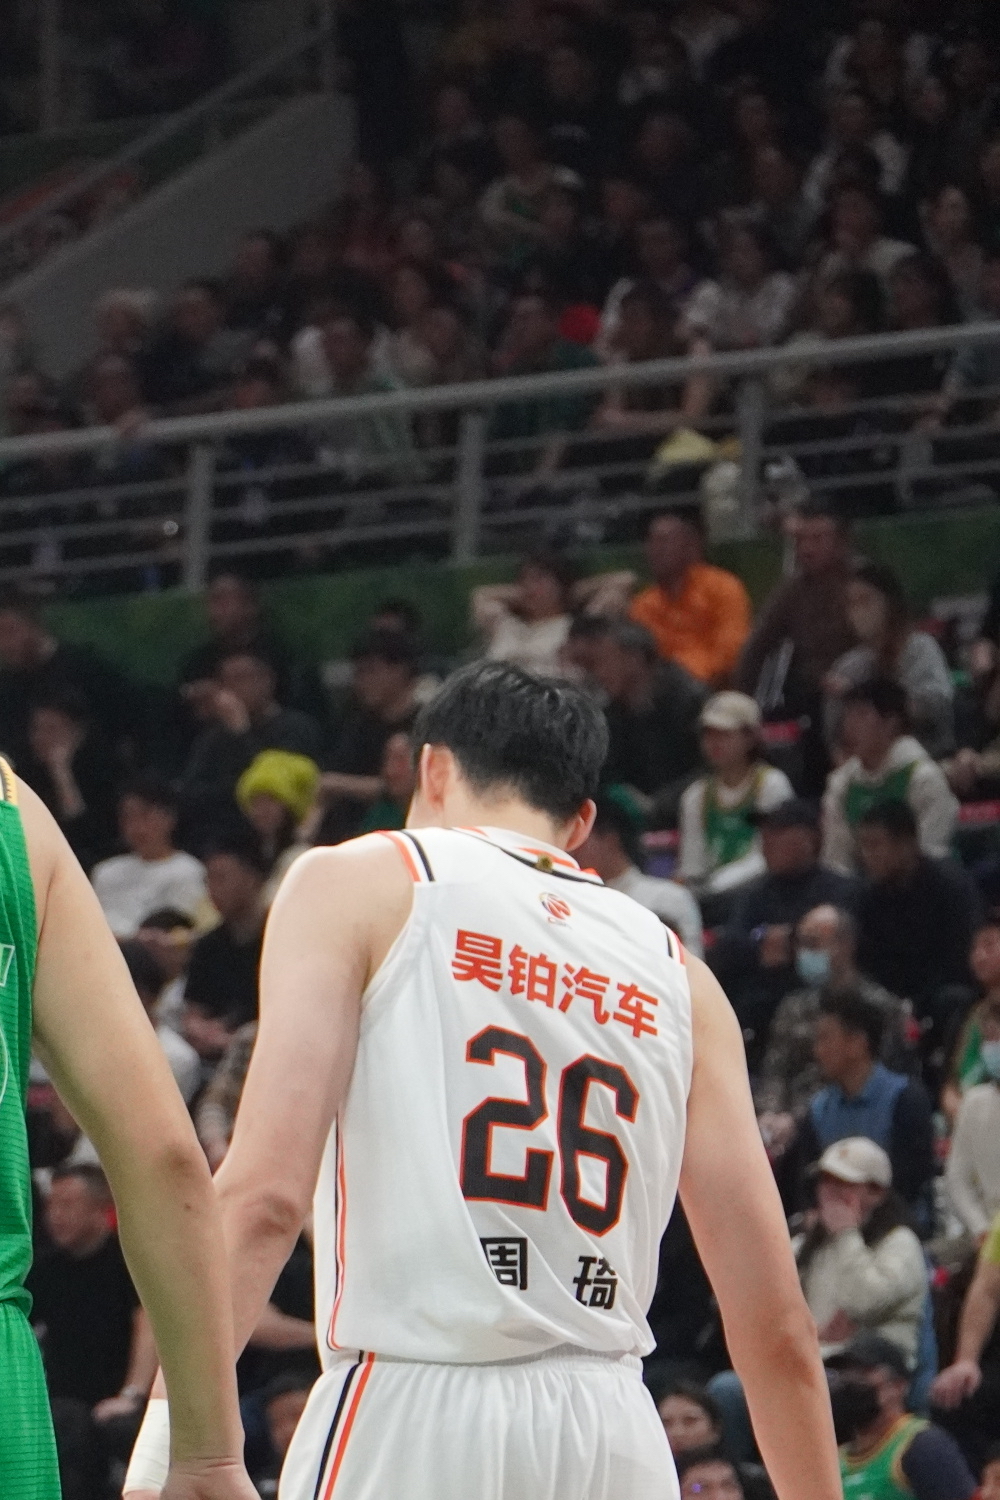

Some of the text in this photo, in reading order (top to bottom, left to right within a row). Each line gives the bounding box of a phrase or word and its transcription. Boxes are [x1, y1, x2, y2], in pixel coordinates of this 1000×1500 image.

[451, 928, 659, 1038] 昊铂汽车
[460, 1024, 640, 1237] 26
